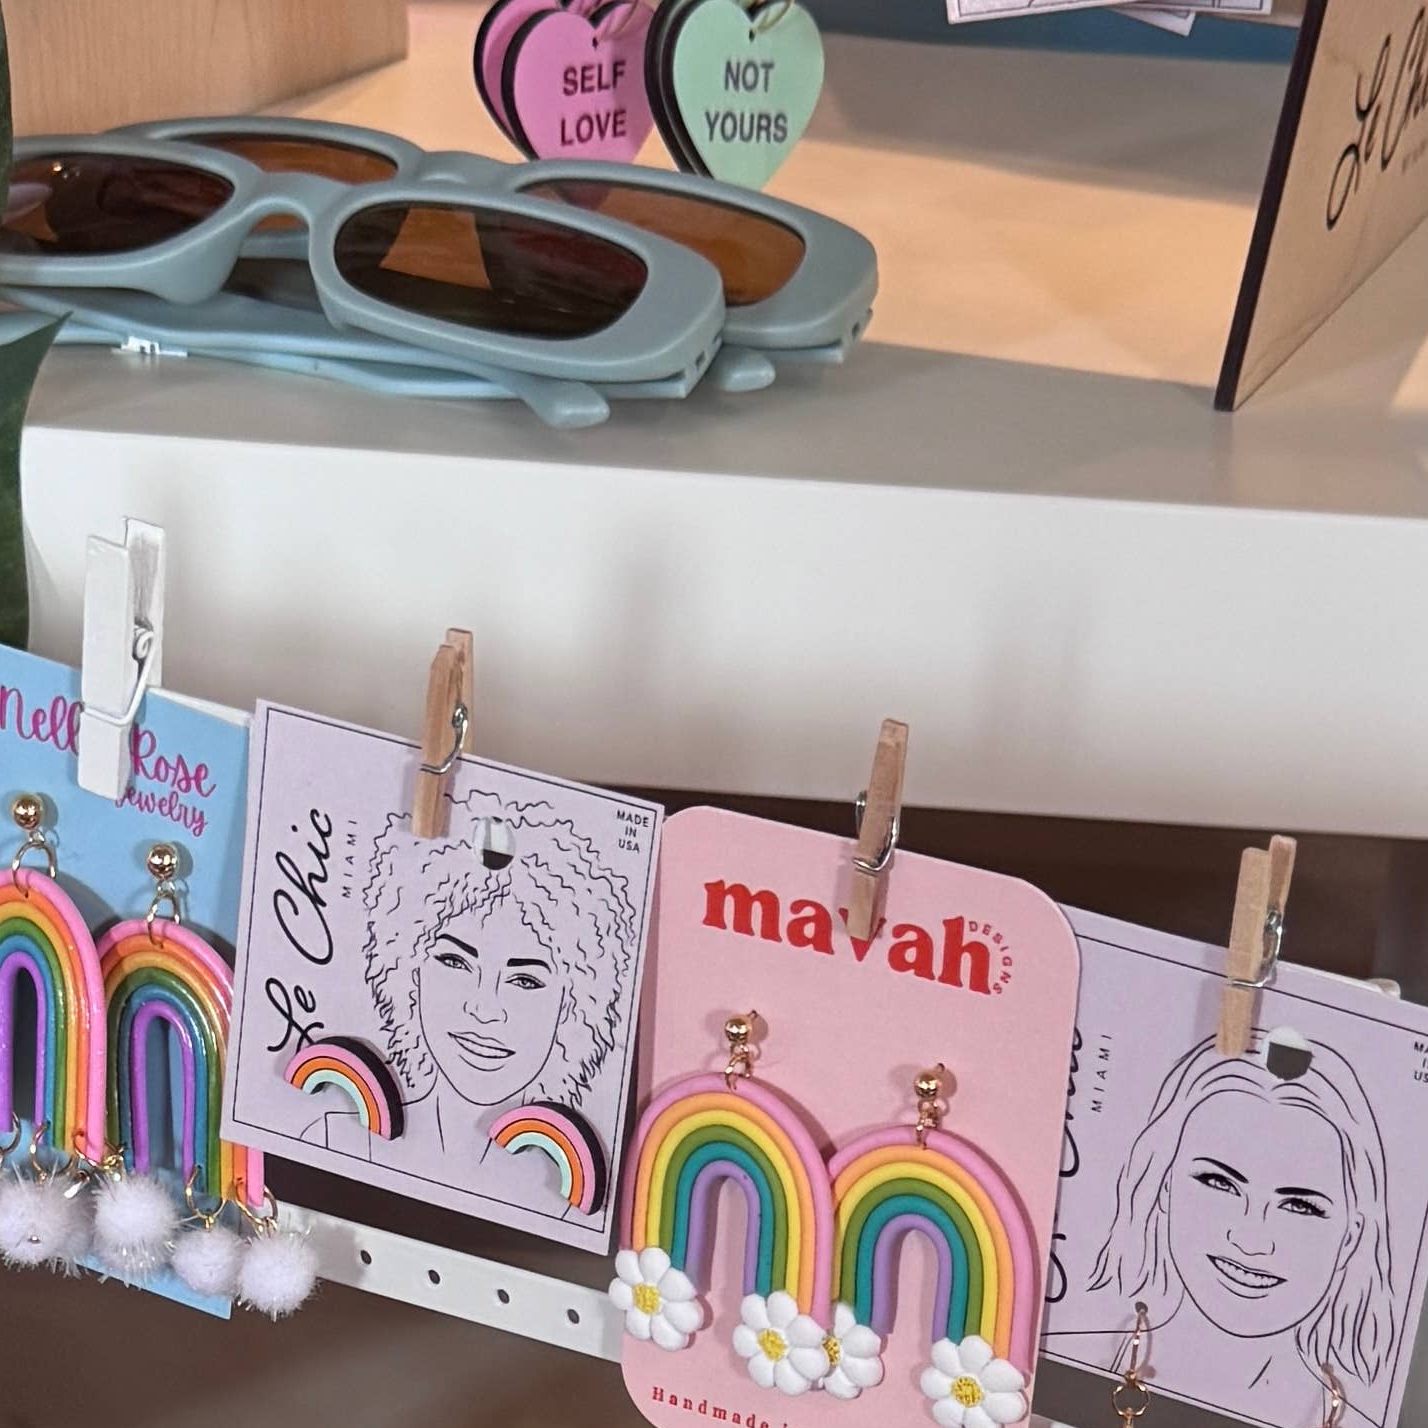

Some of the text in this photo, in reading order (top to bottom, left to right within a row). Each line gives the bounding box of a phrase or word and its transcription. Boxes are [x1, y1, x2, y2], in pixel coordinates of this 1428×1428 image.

[562, 59, 627, 97] SELF
[724, 60, 776, 93] NOT
[560, 108, 627, 147] LOVE
[704, 110, 789, 145] YOURS
[130, 723, 216, 797] Rose
[616, 809, 650, 828] MADE
[624, 826, 638, 837] IN
[341, 819, 358, 899] MIAMI
[617, 839, 641, 854] USA
[265, 808, 333, 1055] Le Chic
[966, 919, 1013, 995] DESIGNS
[1091, 1034, 1113, 1113] MIAMI
